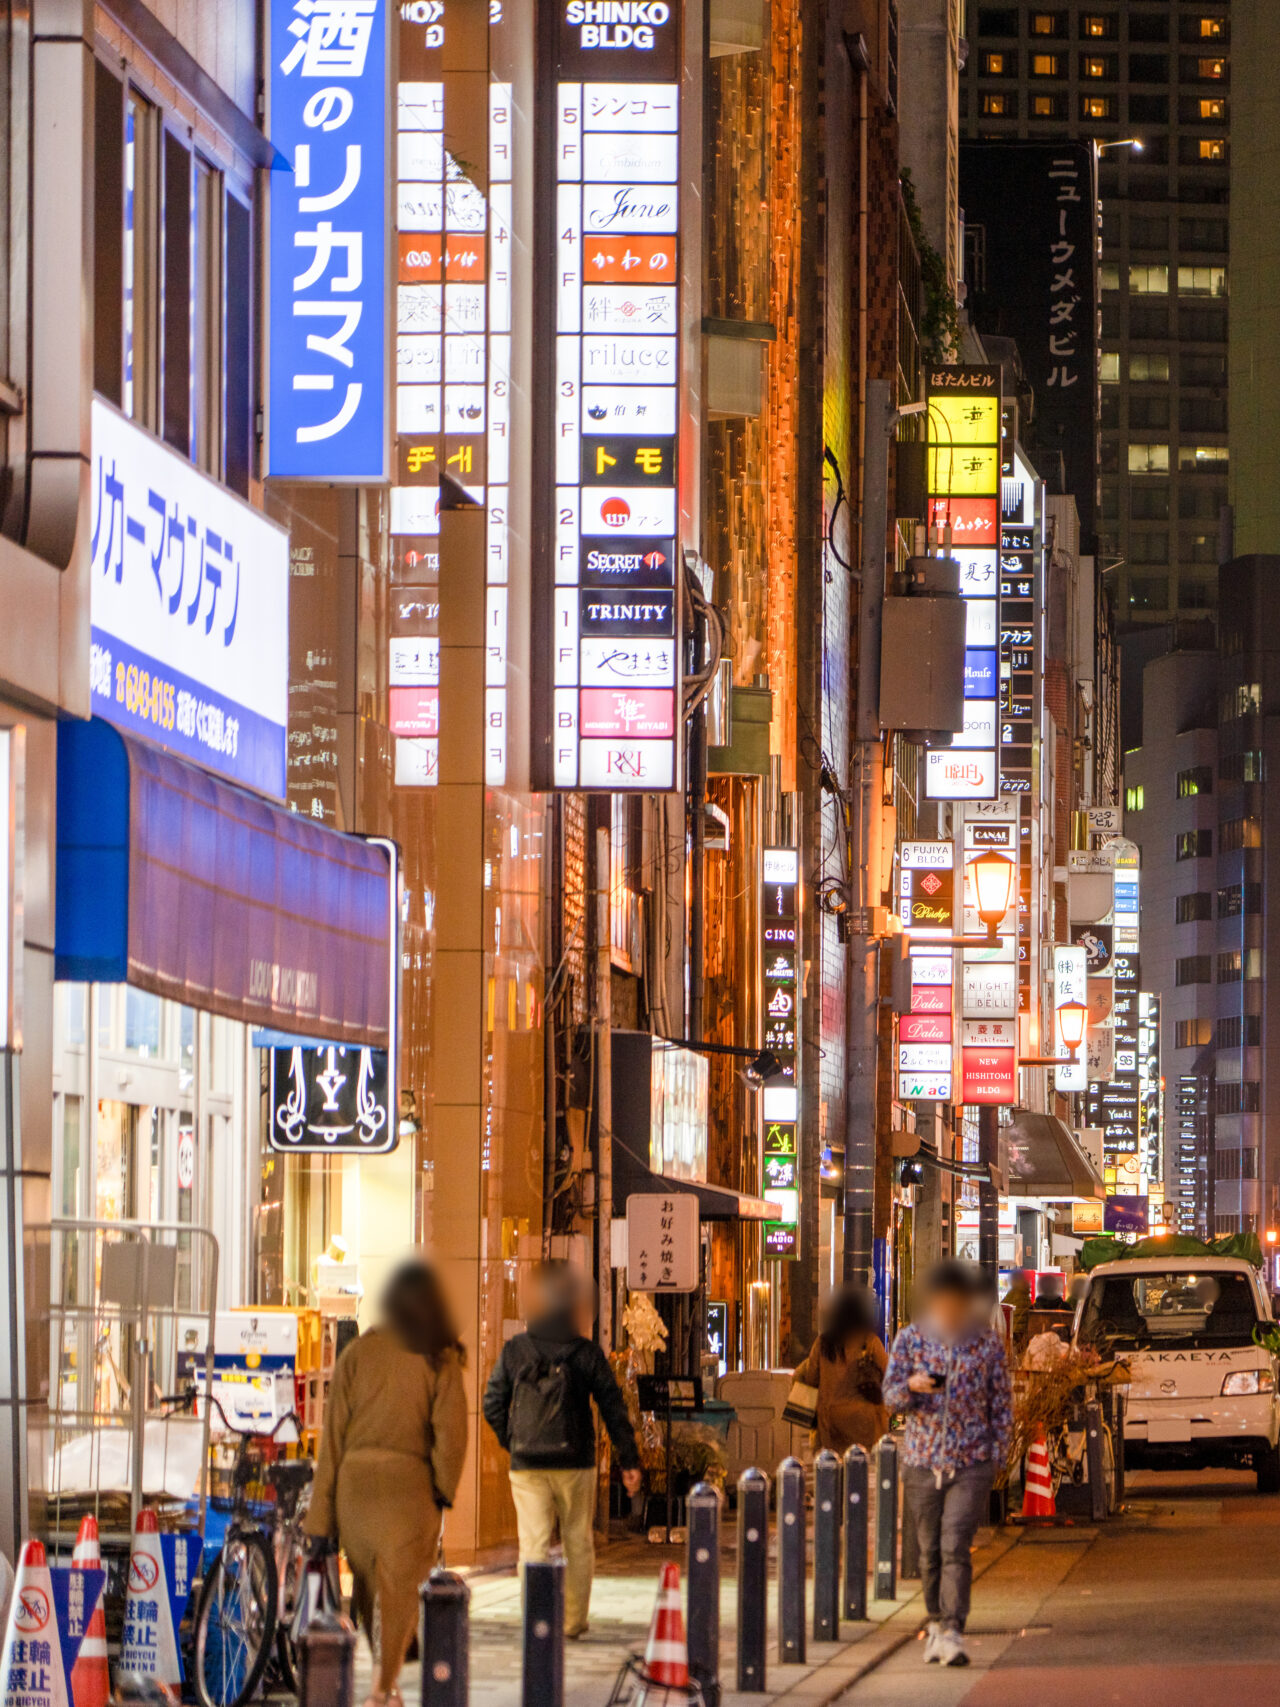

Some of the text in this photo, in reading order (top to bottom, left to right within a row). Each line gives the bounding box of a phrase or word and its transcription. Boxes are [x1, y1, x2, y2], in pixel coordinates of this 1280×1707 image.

[566, 1, 669, 24] SHINKO
[580, 25, 654, 48] BLDG
[590, 96, 671, 117] シンコー
[589, 187, 670, 229] June
[280, 0, 376, 443] 酒のリカマン
[592, 249, 669, 269] かわの
[1047, 158, 1082, 388] ニューウメダビル
[588, 296, 670, 323] 絆 愛
[931, 371, 995, 388] ぼたんビル
[595, 446, 663, 474] トモ
[606, 509, 627, 526] un
[637, 515, 664, 527] アン
[587, 551, 642, 570] SECRET
[588, 604, 667, 620] TRINITY
[597, 651, 670, 677] やまさき
[612, 693, 646, 731] 雅
[637, 721, 668, 729] MIYABI
[930, 754, 944, 764] BF
[1096, 818, 1113, 828] ビル
[975, 831, 1008, 839] CANAL
[903, 848, 909, 861] 6
[913, 846, 949, 854] FUJIYA
[917, 856, 945, 864] BLDG
[902, 877, 910, 890] 5
[902, 906, 910, 919] 5
[765, 929, 795, 941] CINQ
[969, 982, 1009, 990] NIGHT
[977, 999, 1008, 1007] BELL
[907, 1023, 944, 1038] Dalia
[901, 1050, 908, 1064] 2
[966, 1072, 1012, 1080] HISHITOMI
[902, 1080, 906, 1093] 1
[977, 1086, 1000, 1094] BLDG
[660, 1200, 674, 1280] お好み焼き
[1128, 1352, 1232, 1362] SAKAEYA
[8, 1668, 51, 1692] 禁止
